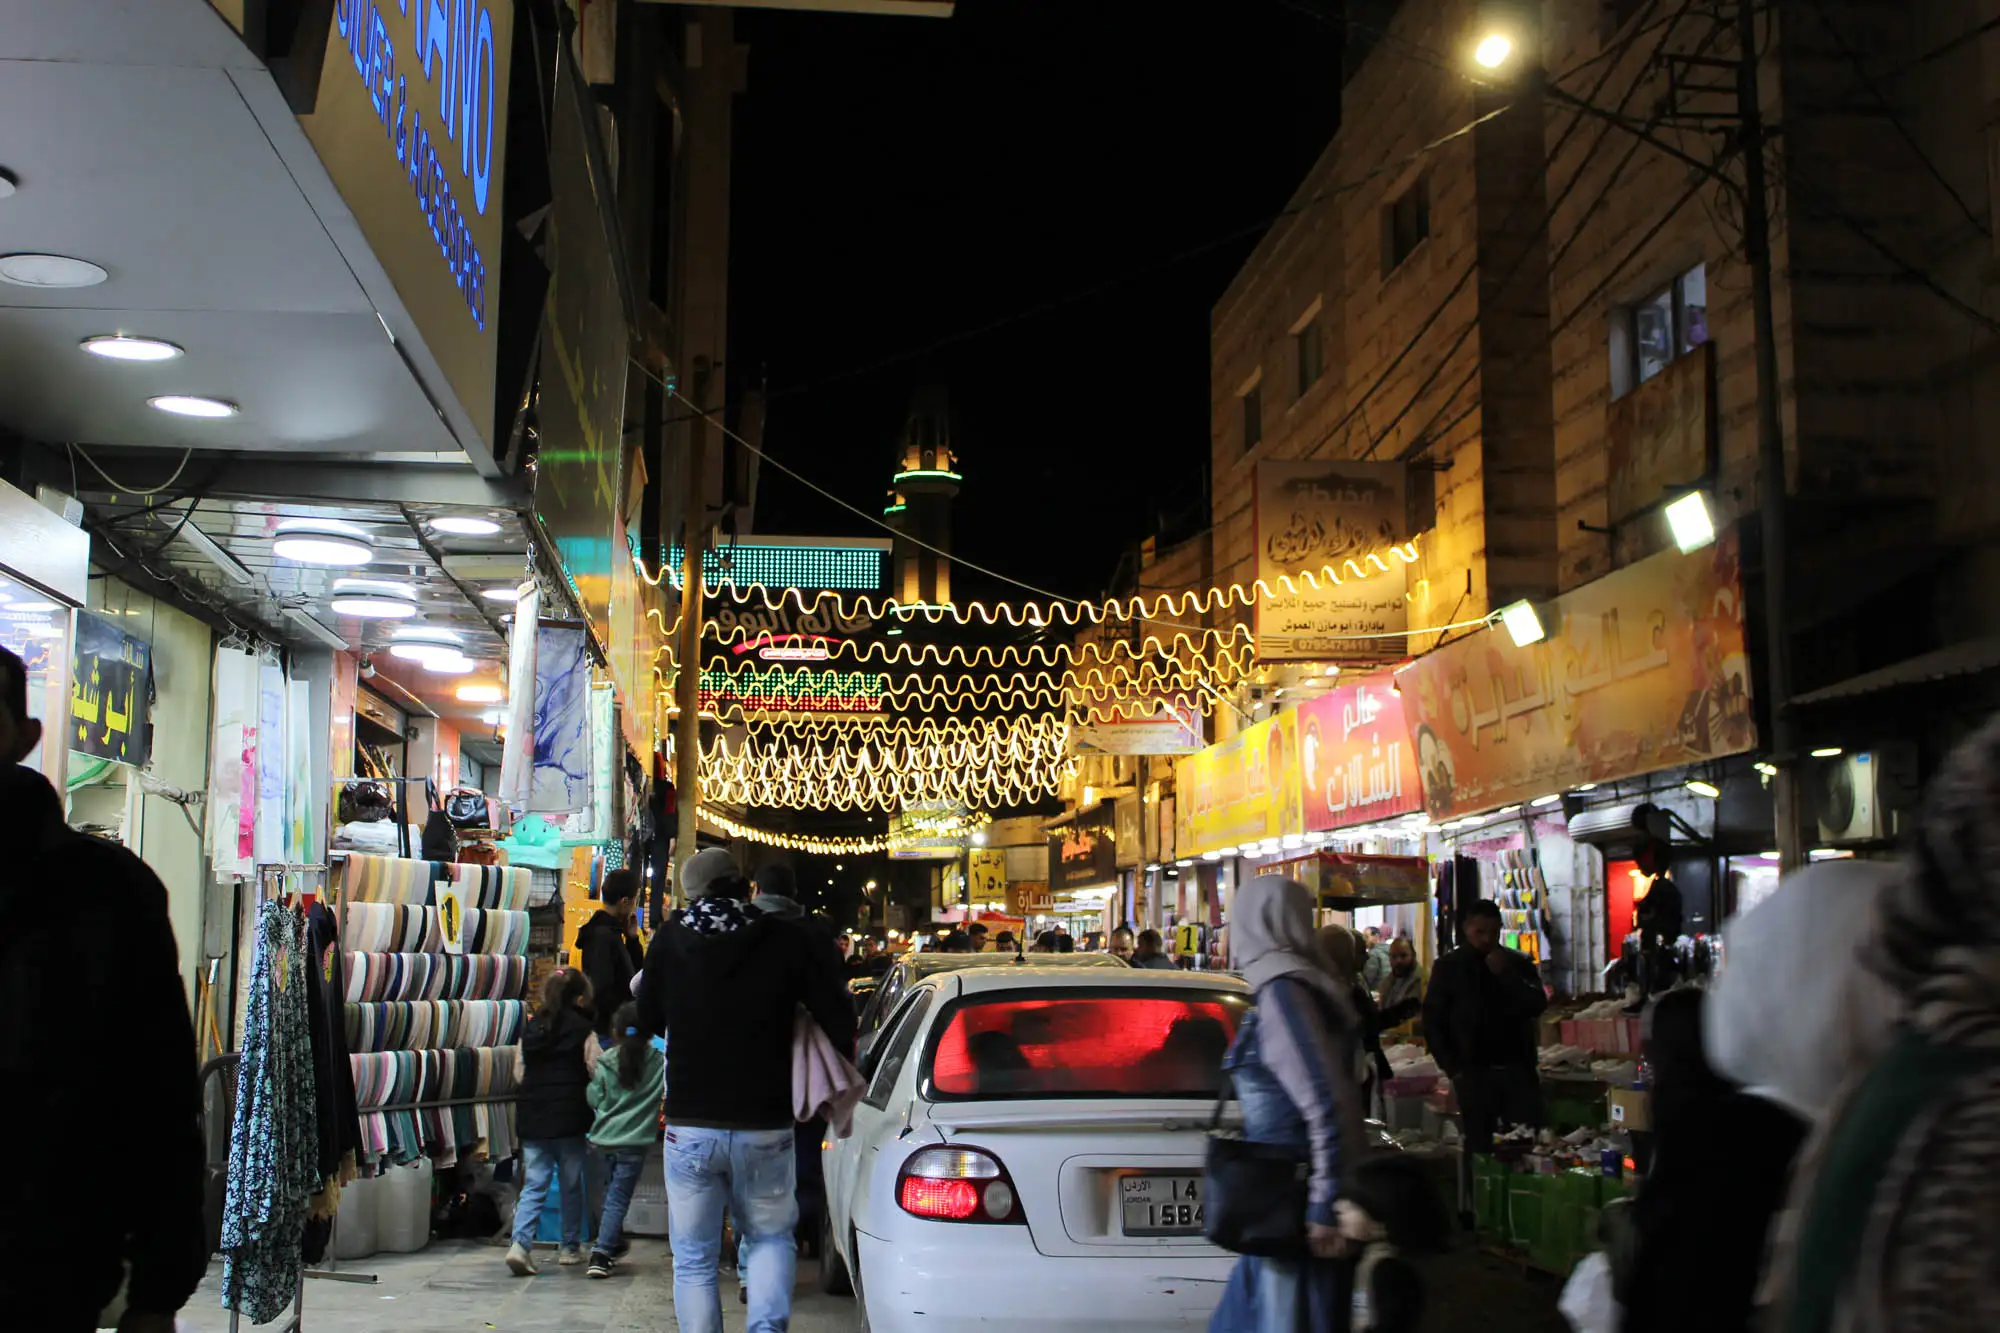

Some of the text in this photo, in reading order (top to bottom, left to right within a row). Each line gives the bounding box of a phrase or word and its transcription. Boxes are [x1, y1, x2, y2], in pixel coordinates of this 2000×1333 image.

[396, 74, 408, 169] &
[409, 110, 485, 333] ACCESSORIES
[1326, 733, 1402, 812] الشالات
[1183, 926, 1192, 951] 1
[1124, 1196, 1151, 1204] JORDAN
